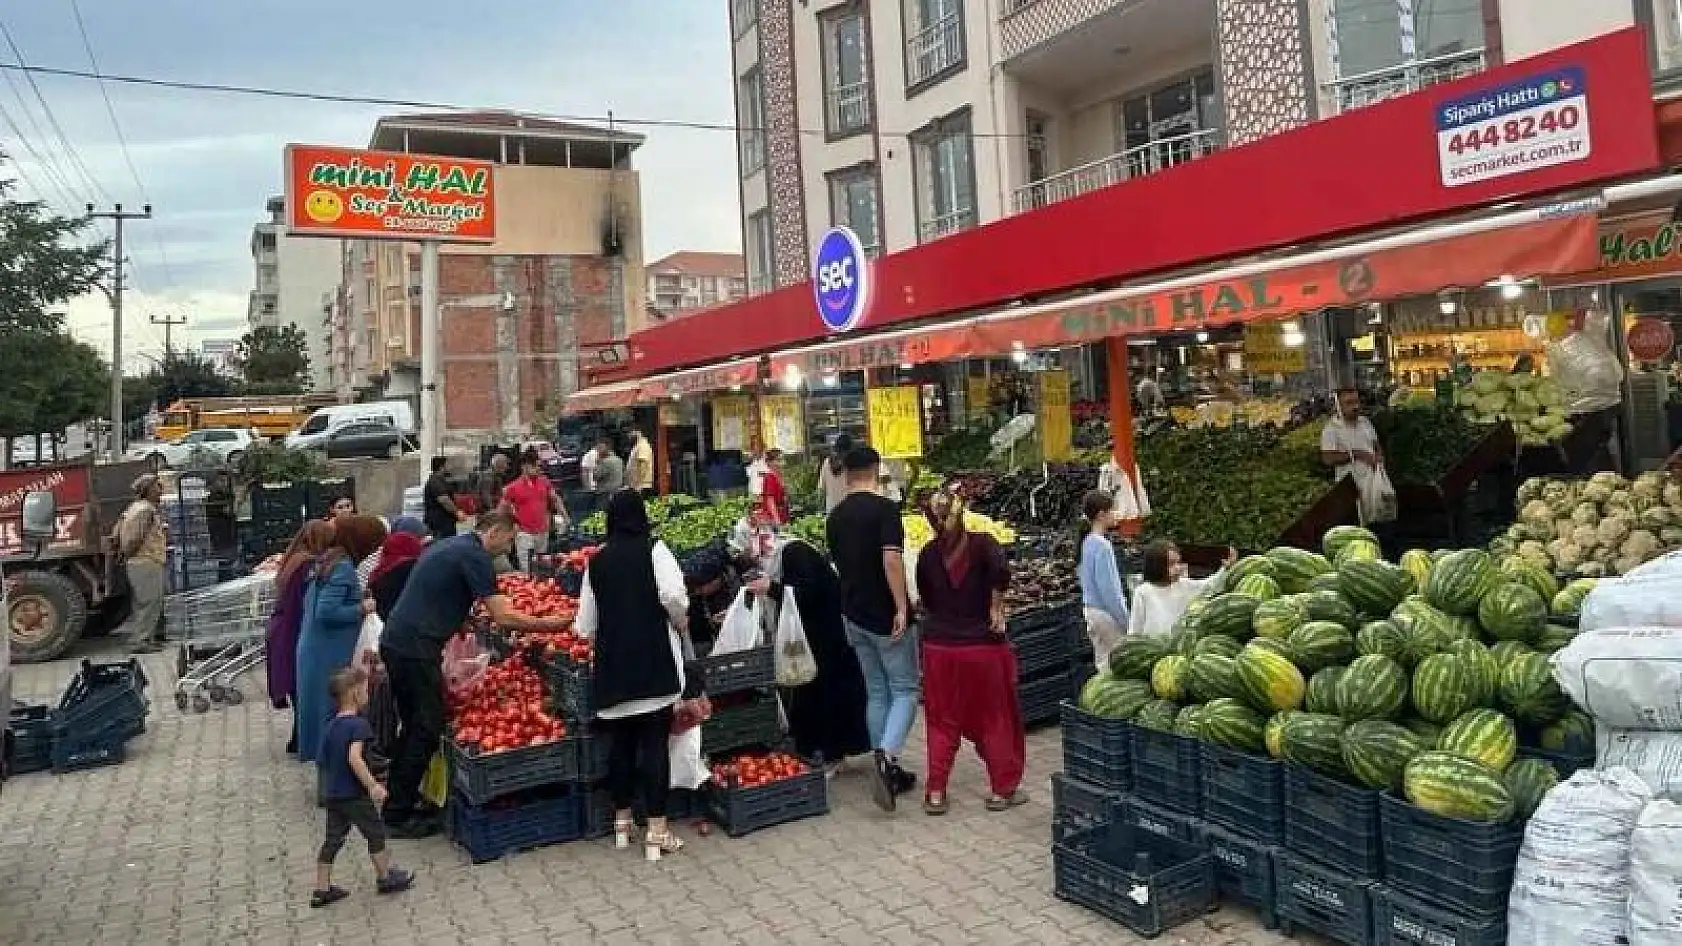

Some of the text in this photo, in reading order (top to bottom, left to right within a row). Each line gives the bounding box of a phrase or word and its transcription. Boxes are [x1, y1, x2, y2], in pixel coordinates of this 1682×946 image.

[1444, 98, 1496, 124] Sipariş
[1450, 140, 1582, 180] secmarket.com.tr
[404, 162, 488, 195] HAL
[401, 196, 486, 223] Market
[818, 257, 853, 294] sec
[1170, 277, 1283, 323] HAL
